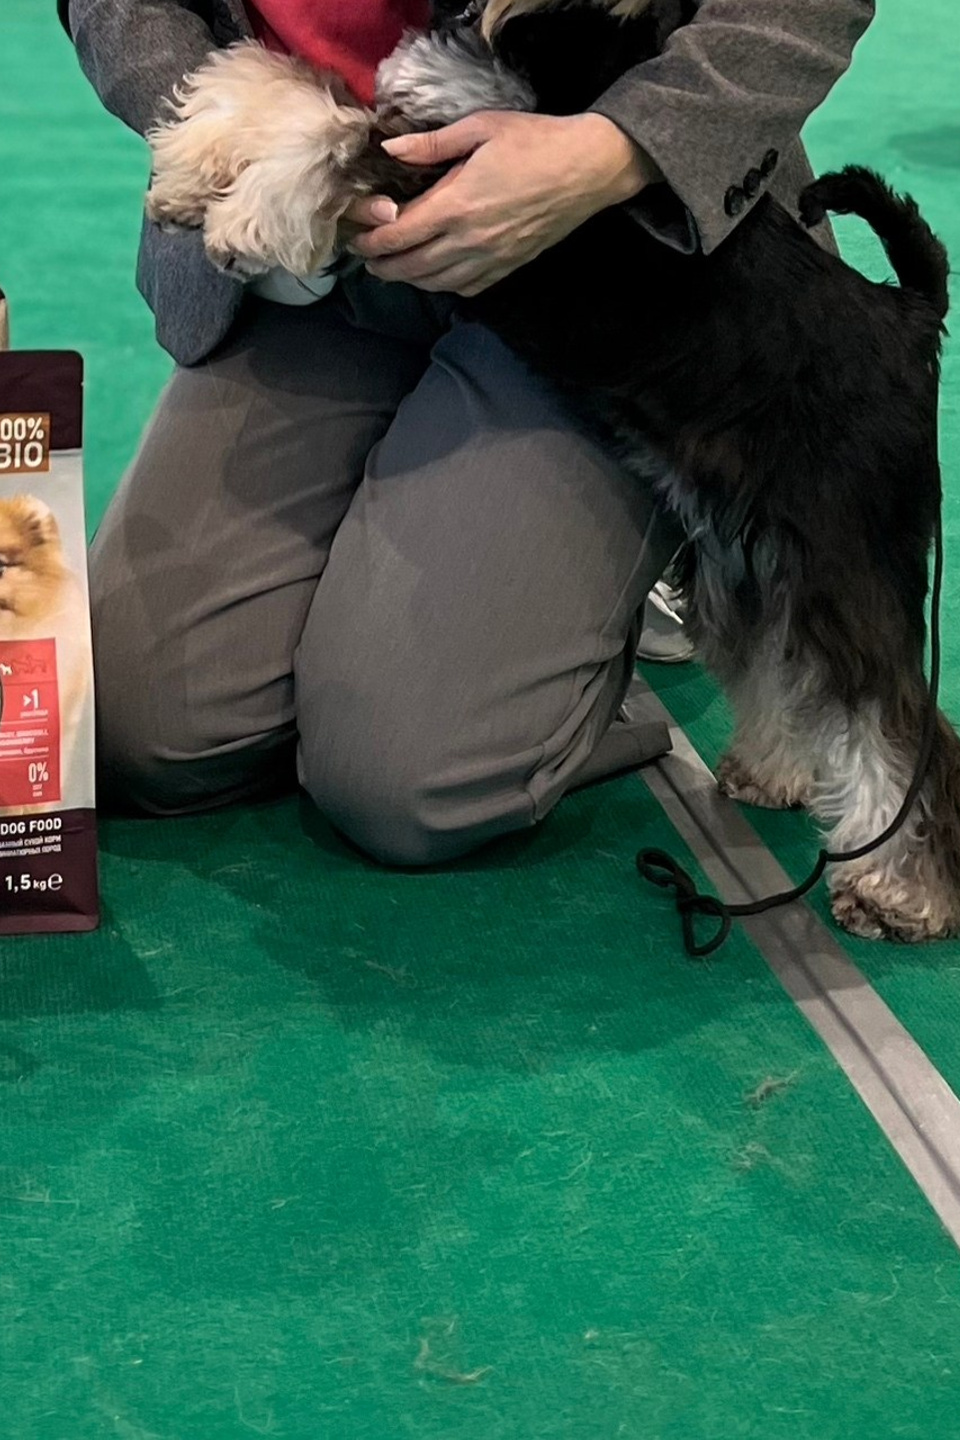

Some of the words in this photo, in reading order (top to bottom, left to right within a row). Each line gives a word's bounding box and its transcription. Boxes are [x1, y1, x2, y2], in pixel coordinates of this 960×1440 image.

[28, 761, 50, 783] 0%
[0, 821, 26, 836] DOG
[29, 817, 63, 833] FOOD
[5, 874, 32, 893] 1,5
